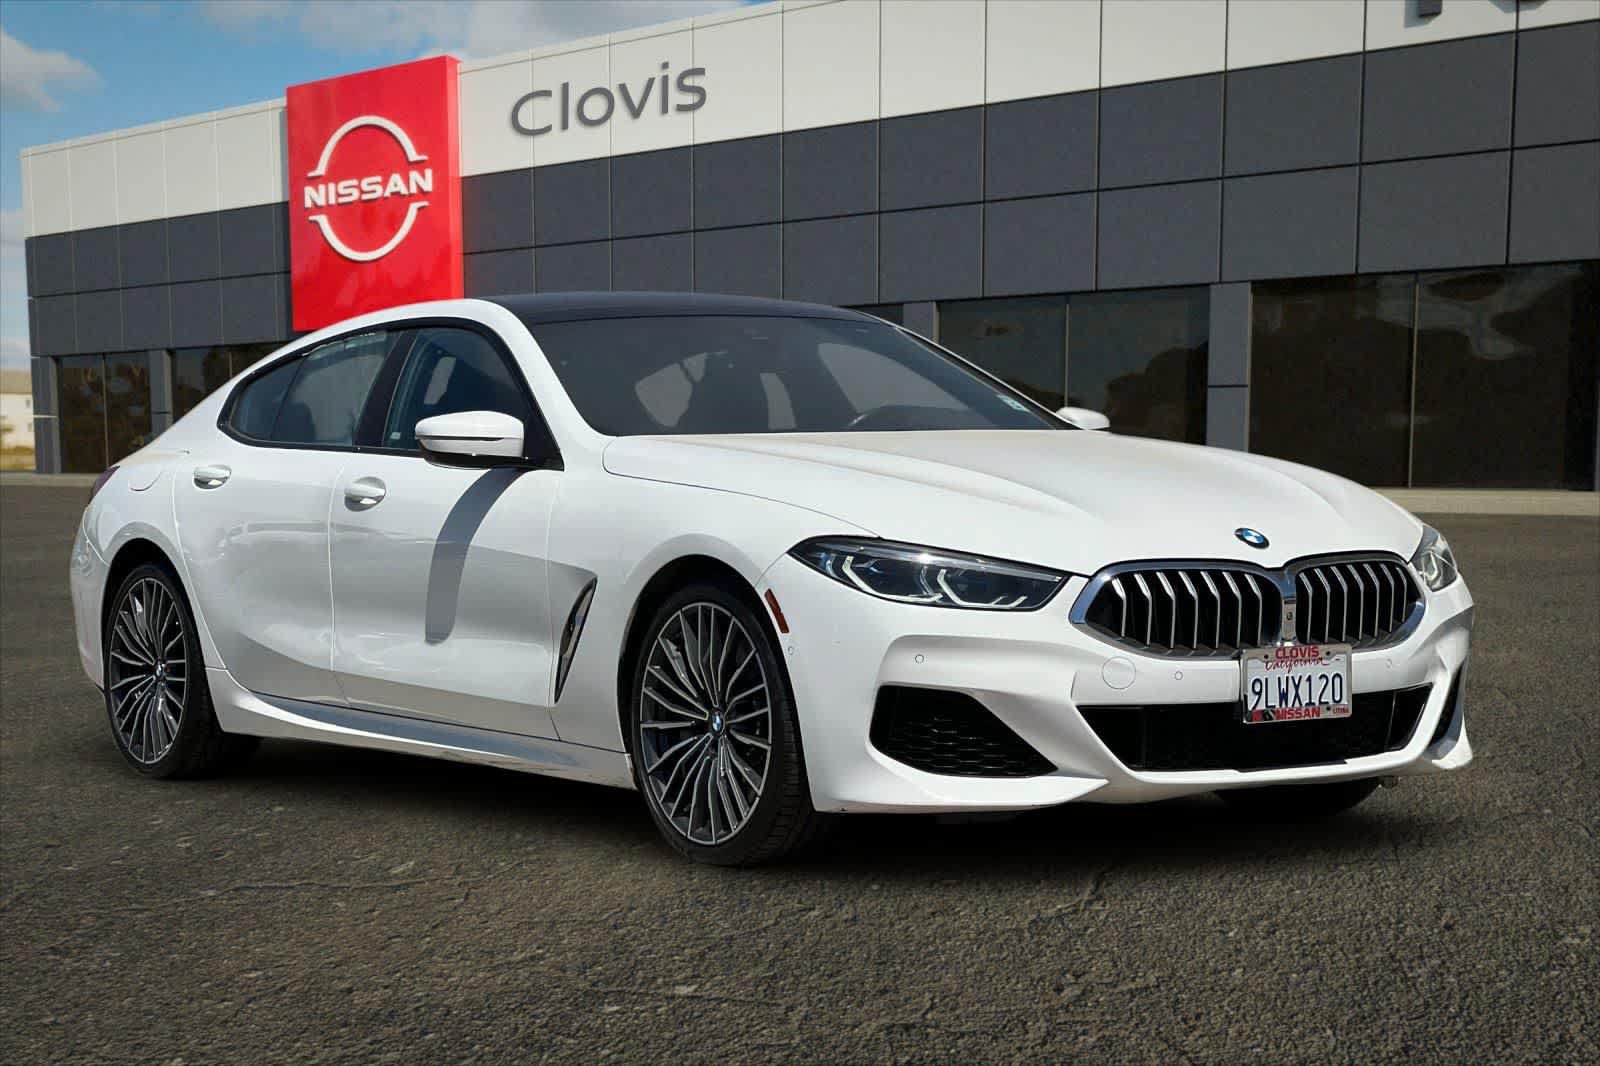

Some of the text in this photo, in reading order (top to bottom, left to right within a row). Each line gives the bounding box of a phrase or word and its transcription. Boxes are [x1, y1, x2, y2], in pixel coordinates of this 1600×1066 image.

[511, 61, 707, 136] Clovis
[303, 168, 433, 208] NISSAN
[1275, 646, 1320, 659] CLOVIS
[1251, 673, 1343, 710] 9LWX120
[1275, 706, 1321, 720] NISSAN
